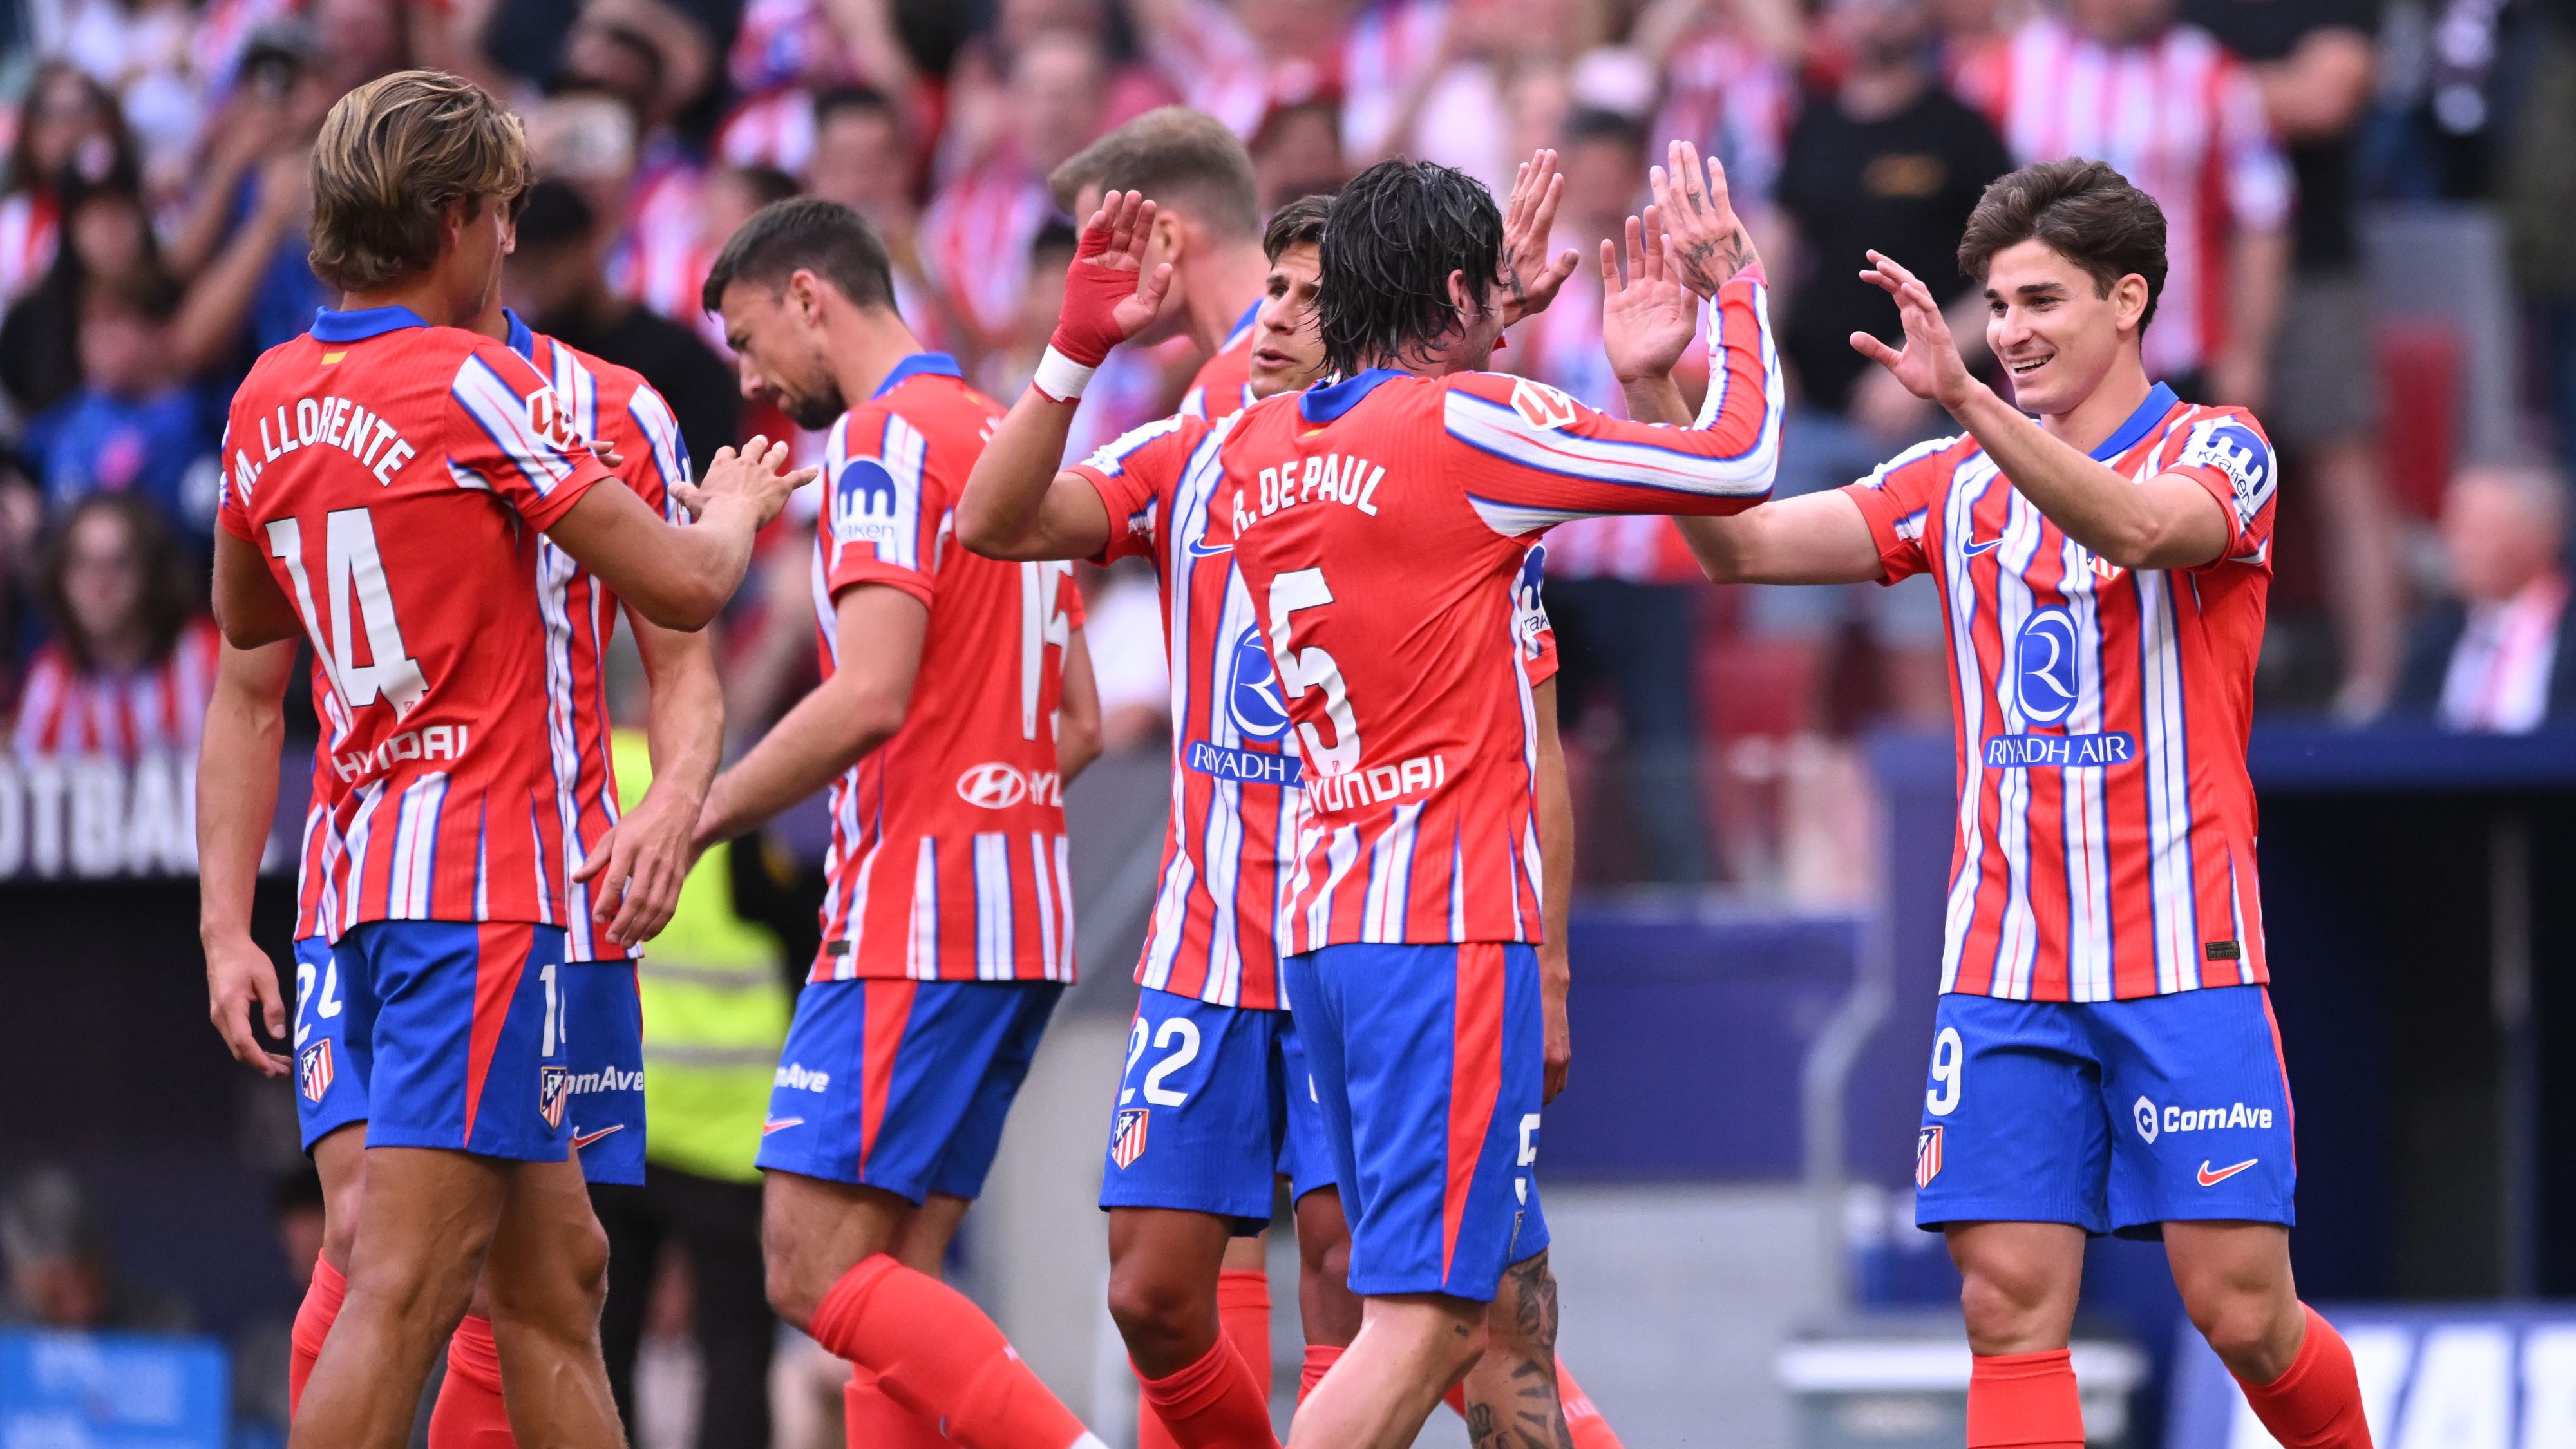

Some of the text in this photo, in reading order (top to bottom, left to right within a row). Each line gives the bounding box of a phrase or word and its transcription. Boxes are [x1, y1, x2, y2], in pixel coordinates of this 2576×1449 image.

[235, 397, 417, 507] M. LLORENTE
[2197, 451, 2249, 506] kraken
[1233, 454, 1385, 540] R. DE PAUL
[265, 507, 430, 732] 14
[1522, 615, 1549, 633] rak
[1269, 567, 1360, 777] 5
[1193, 743, 1284, 781] RIYADH
[1988, 736, 2128, 764] RIYADH AIR
[0, 755, 281, 875] OTBA
[538, 965, 565, 1057] 1
[566, 1066, 644, 1094] omAve
[1119, 1017, 1200, 1107] 22
[1926, 1027, 1963, 1116] 9
[2164, 1103, 2272, 1132] ComAve
